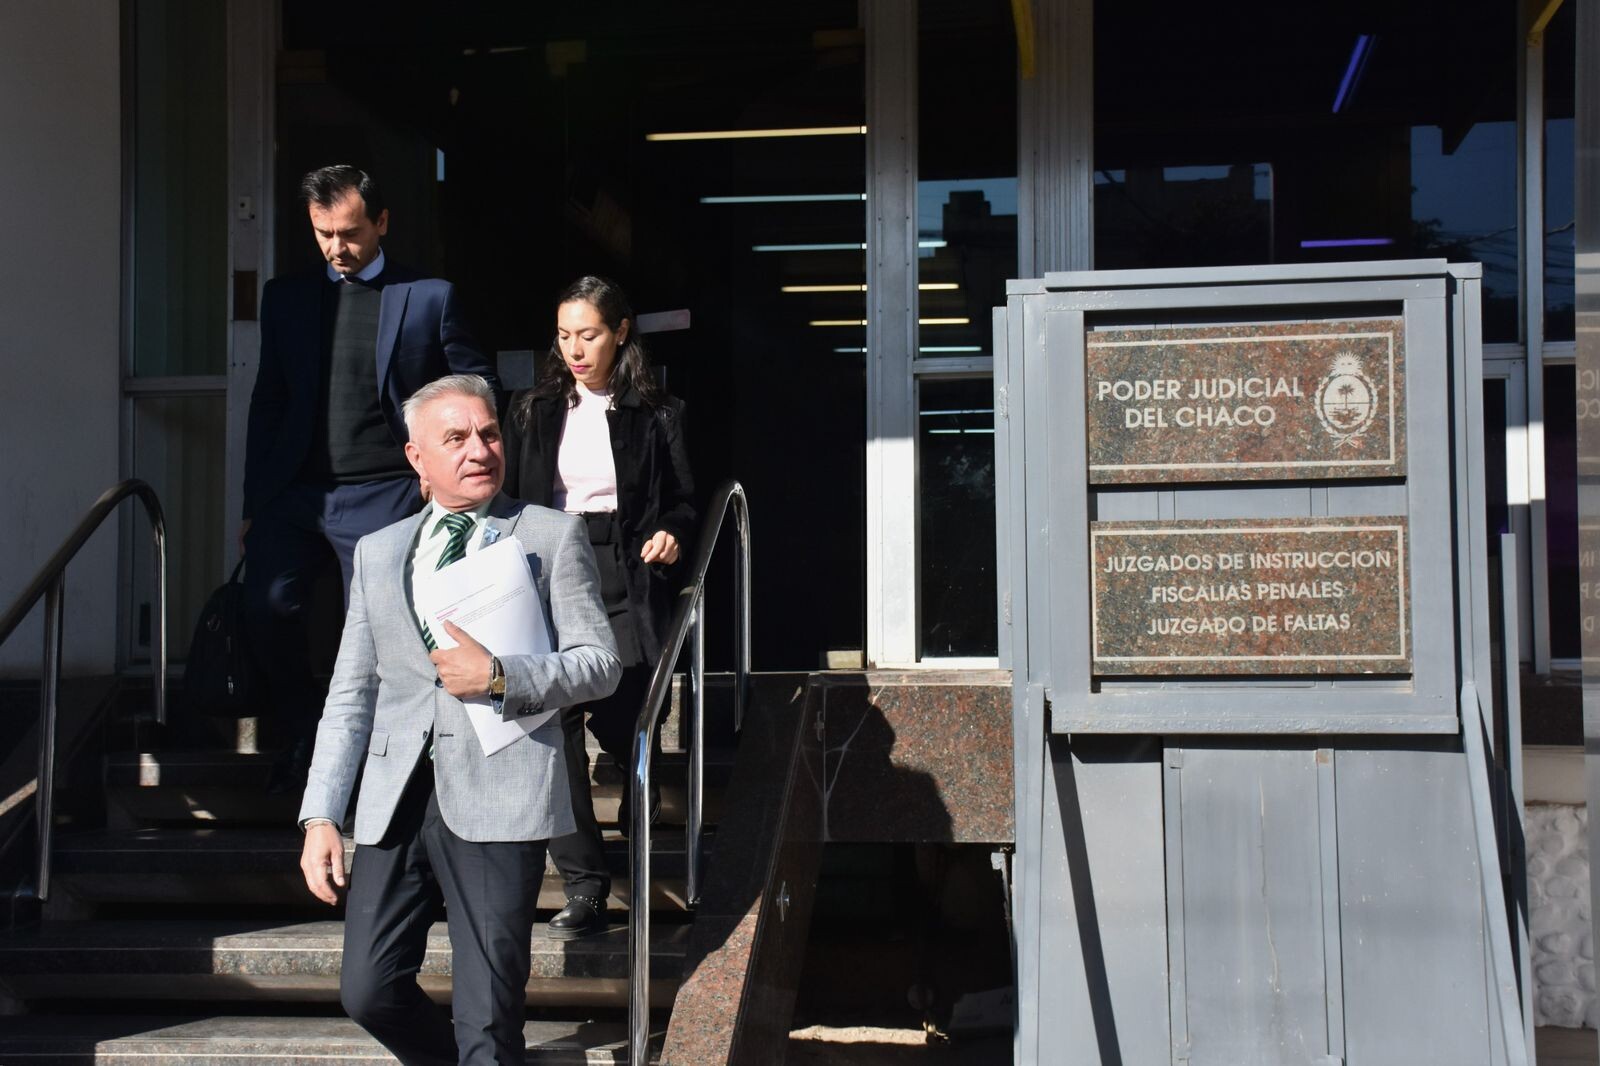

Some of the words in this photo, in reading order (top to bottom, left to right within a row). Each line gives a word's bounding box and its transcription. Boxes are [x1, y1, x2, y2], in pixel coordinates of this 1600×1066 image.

[1098, 379, 1181, 401] PODER
[1188, 377, 1304, 400] JUDICIAL
[1125, 407, 1168, 428] DEL
[1175, 405, 1276, 427] CHACO
[1104, 554, 1213, 572] JUZGADOS
[1219, 553, 1243, 570] DE
[1250, 551, 1391, 569] INSTRUCCION
[1151, 584, 1252, 603] FISCALIAS
[1257, 581, 1343, 600] PENALES
[1147, 616, 1246, 635] JUZGADO
[1252, 615, 1277, 632] DE
[1284, 613, 1351, 632] FALTAS
